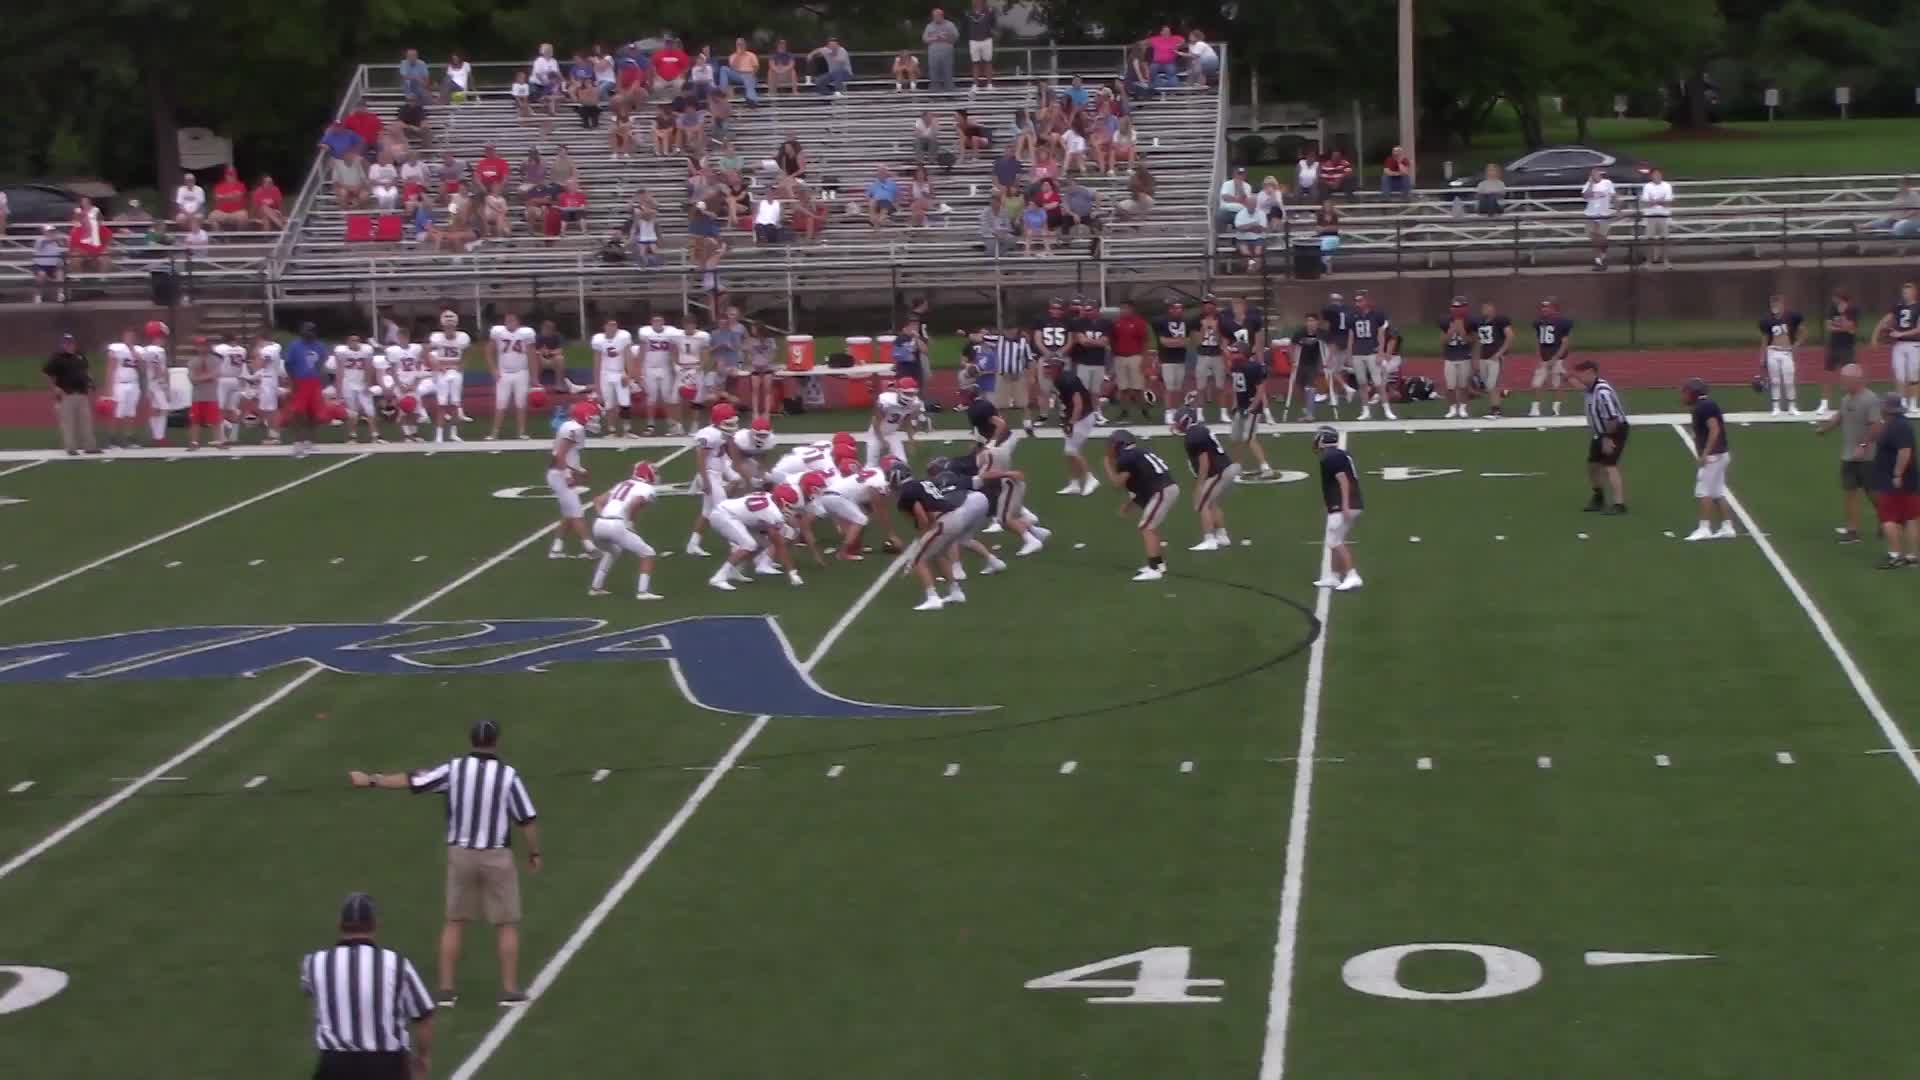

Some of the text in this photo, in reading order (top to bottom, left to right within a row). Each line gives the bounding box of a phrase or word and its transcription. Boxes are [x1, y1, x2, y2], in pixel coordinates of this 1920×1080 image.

[1899, 309, 1911, 328] 2
[1042, 327, 1065, 346] 55
[1540, 325, 1555, 344] 16
